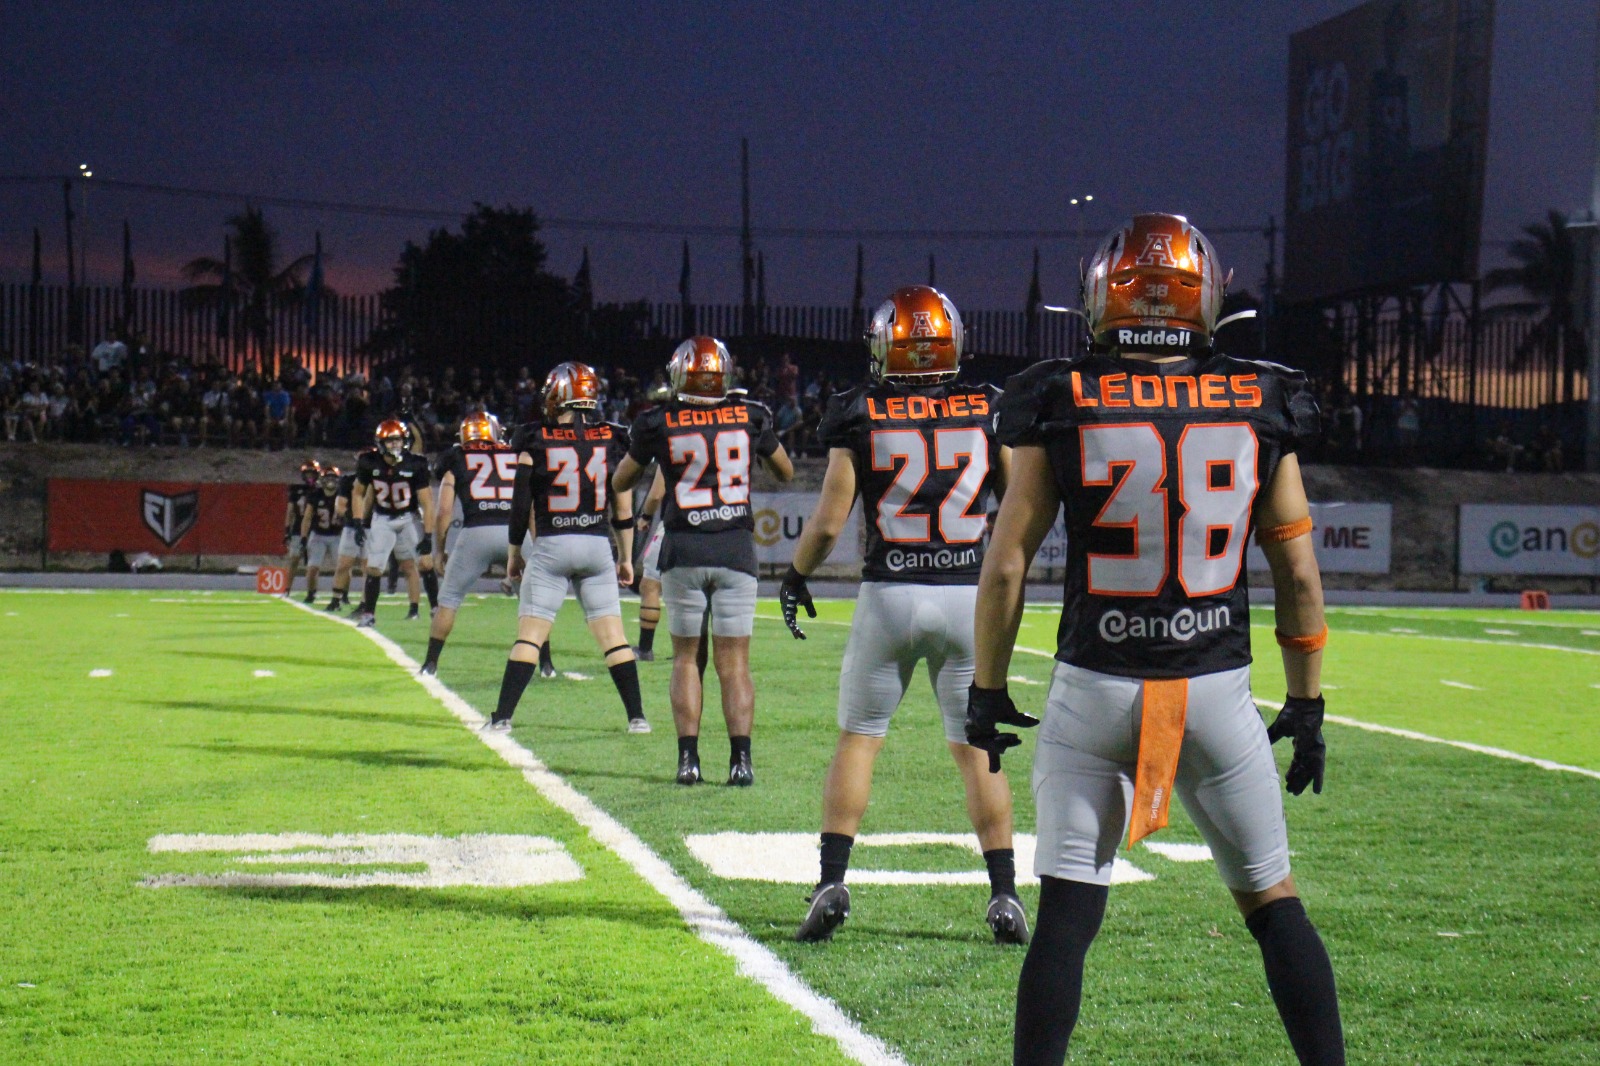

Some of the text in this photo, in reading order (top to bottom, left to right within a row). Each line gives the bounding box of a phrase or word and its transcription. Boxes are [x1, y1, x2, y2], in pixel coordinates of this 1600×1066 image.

[1118, 329, 1191, 346] Riddell
[1071, 371, 1262, 408] LEONES
[666, 406, 749, 428] LEONES
[867, 394, 989, 420] LEONES
[542, 426, 613, 441] LEOES
[465, 453, 518, 500] 25
[546, 447, 607, 512] 31
[668, 429, 750, 508] 28
[372, 479, 412, 510] 20
[871, 427, 990, 544] 22
[1078, 421, 1260, 598] 38
[1323, 526, 1371, 549] ME
[261, 569, 284, 591] 30
